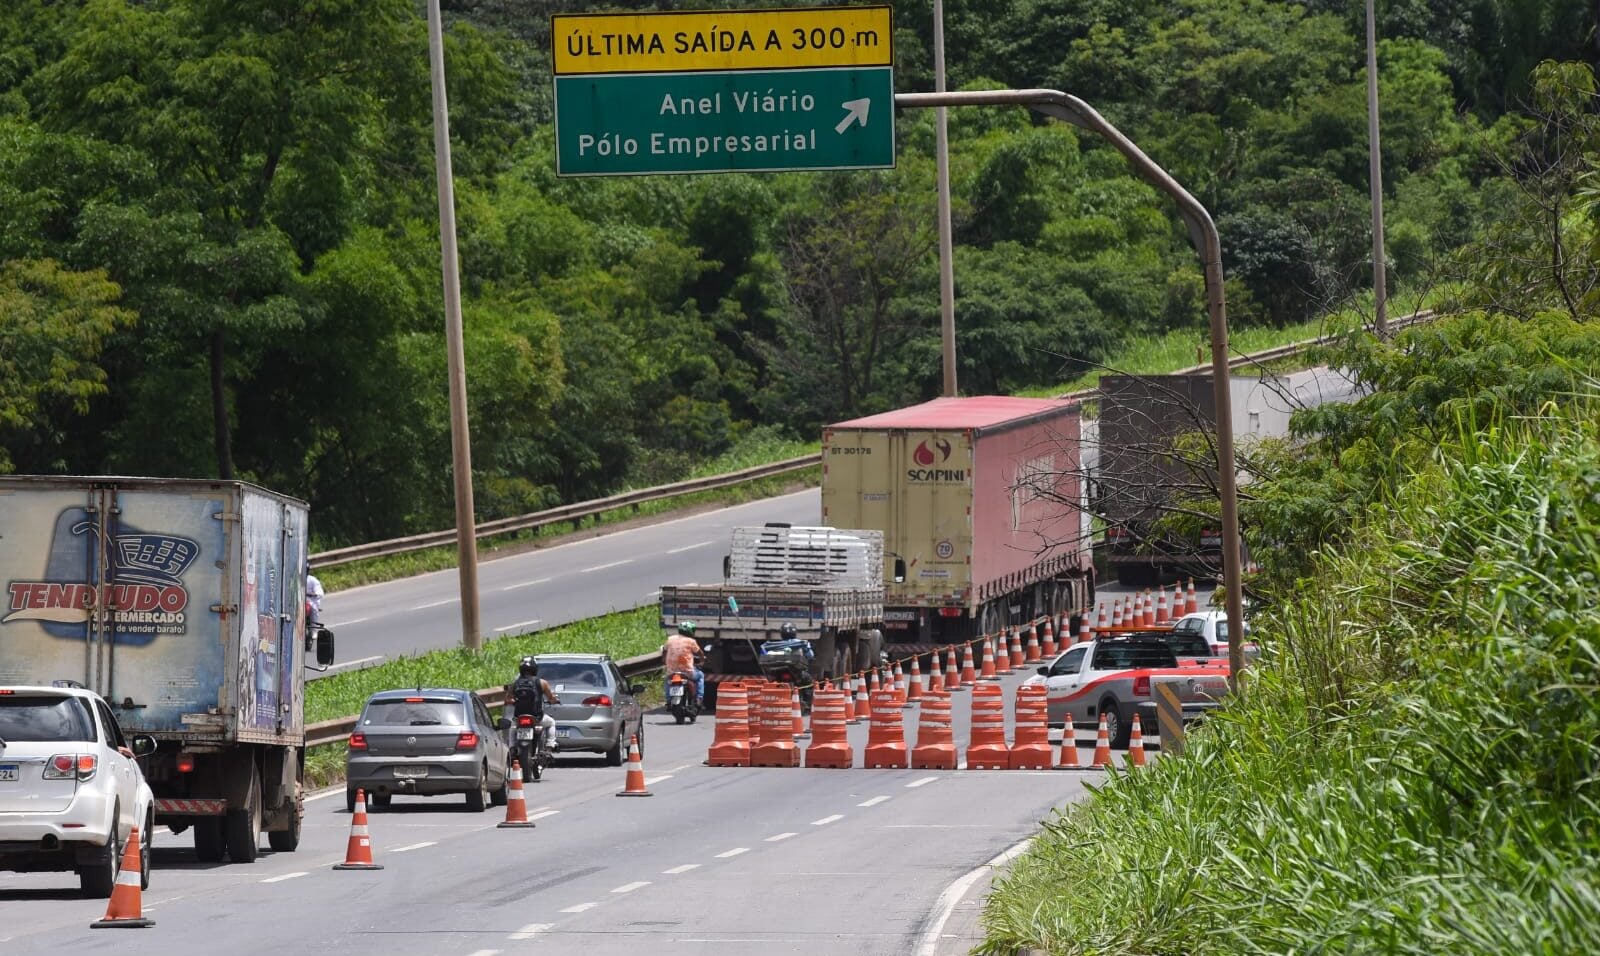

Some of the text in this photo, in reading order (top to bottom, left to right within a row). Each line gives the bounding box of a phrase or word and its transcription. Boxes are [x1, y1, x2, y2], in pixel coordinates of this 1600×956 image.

[567, 29, 665, 57] ÚLTIMA
[674, 25, 755, 53] SAÍDA
[764, 29, 782, 51] A
[792, 27, 846, 49] 300
[660, 88, 815, 115] Anel Viário
[579, 129, 816, 157] Pólo Empresarial
[907, 469, 964, 482] SCAPINI
[92, 612, 185, 623] SUERMERCADO
[116, 624, 126, 632] de
[128, 624, 155, 632] vender
